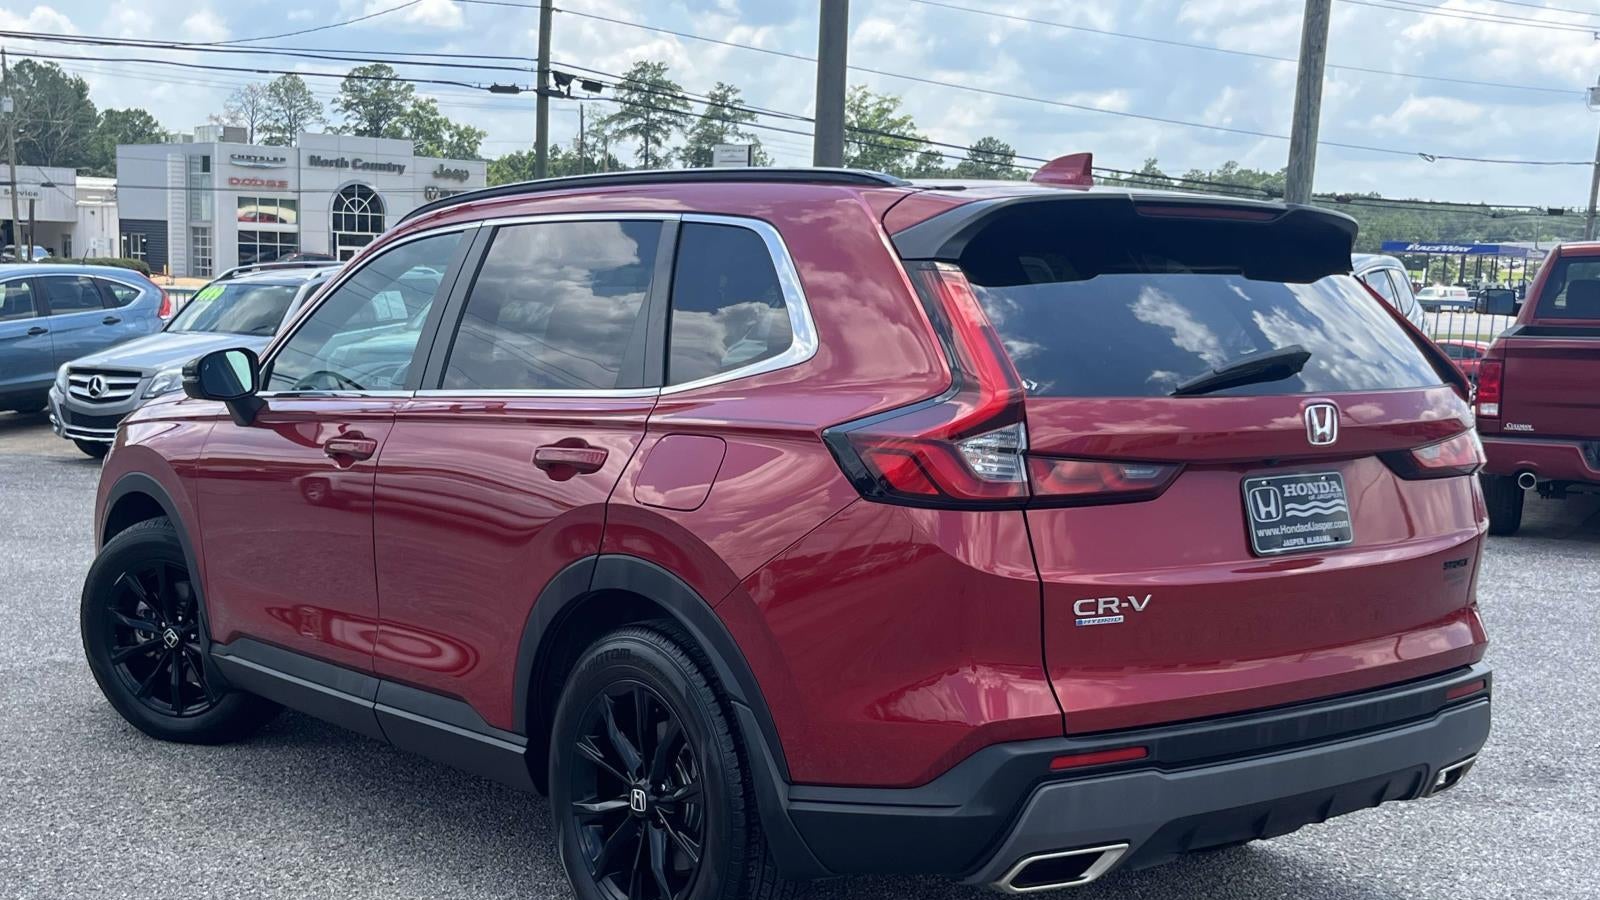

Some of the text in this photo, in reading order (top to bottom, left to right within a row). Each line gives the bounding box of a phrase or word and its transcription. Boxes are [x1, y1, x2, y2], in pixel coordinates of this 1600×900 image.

[309, 155, 406, 175] North Country
[433, 164, 469, 182] Jeep
[228, 177, 288, 188] DODGE
[1282, 481, 1342, 497] HONDA
[1073, 594, 1152, 616] CR-V
